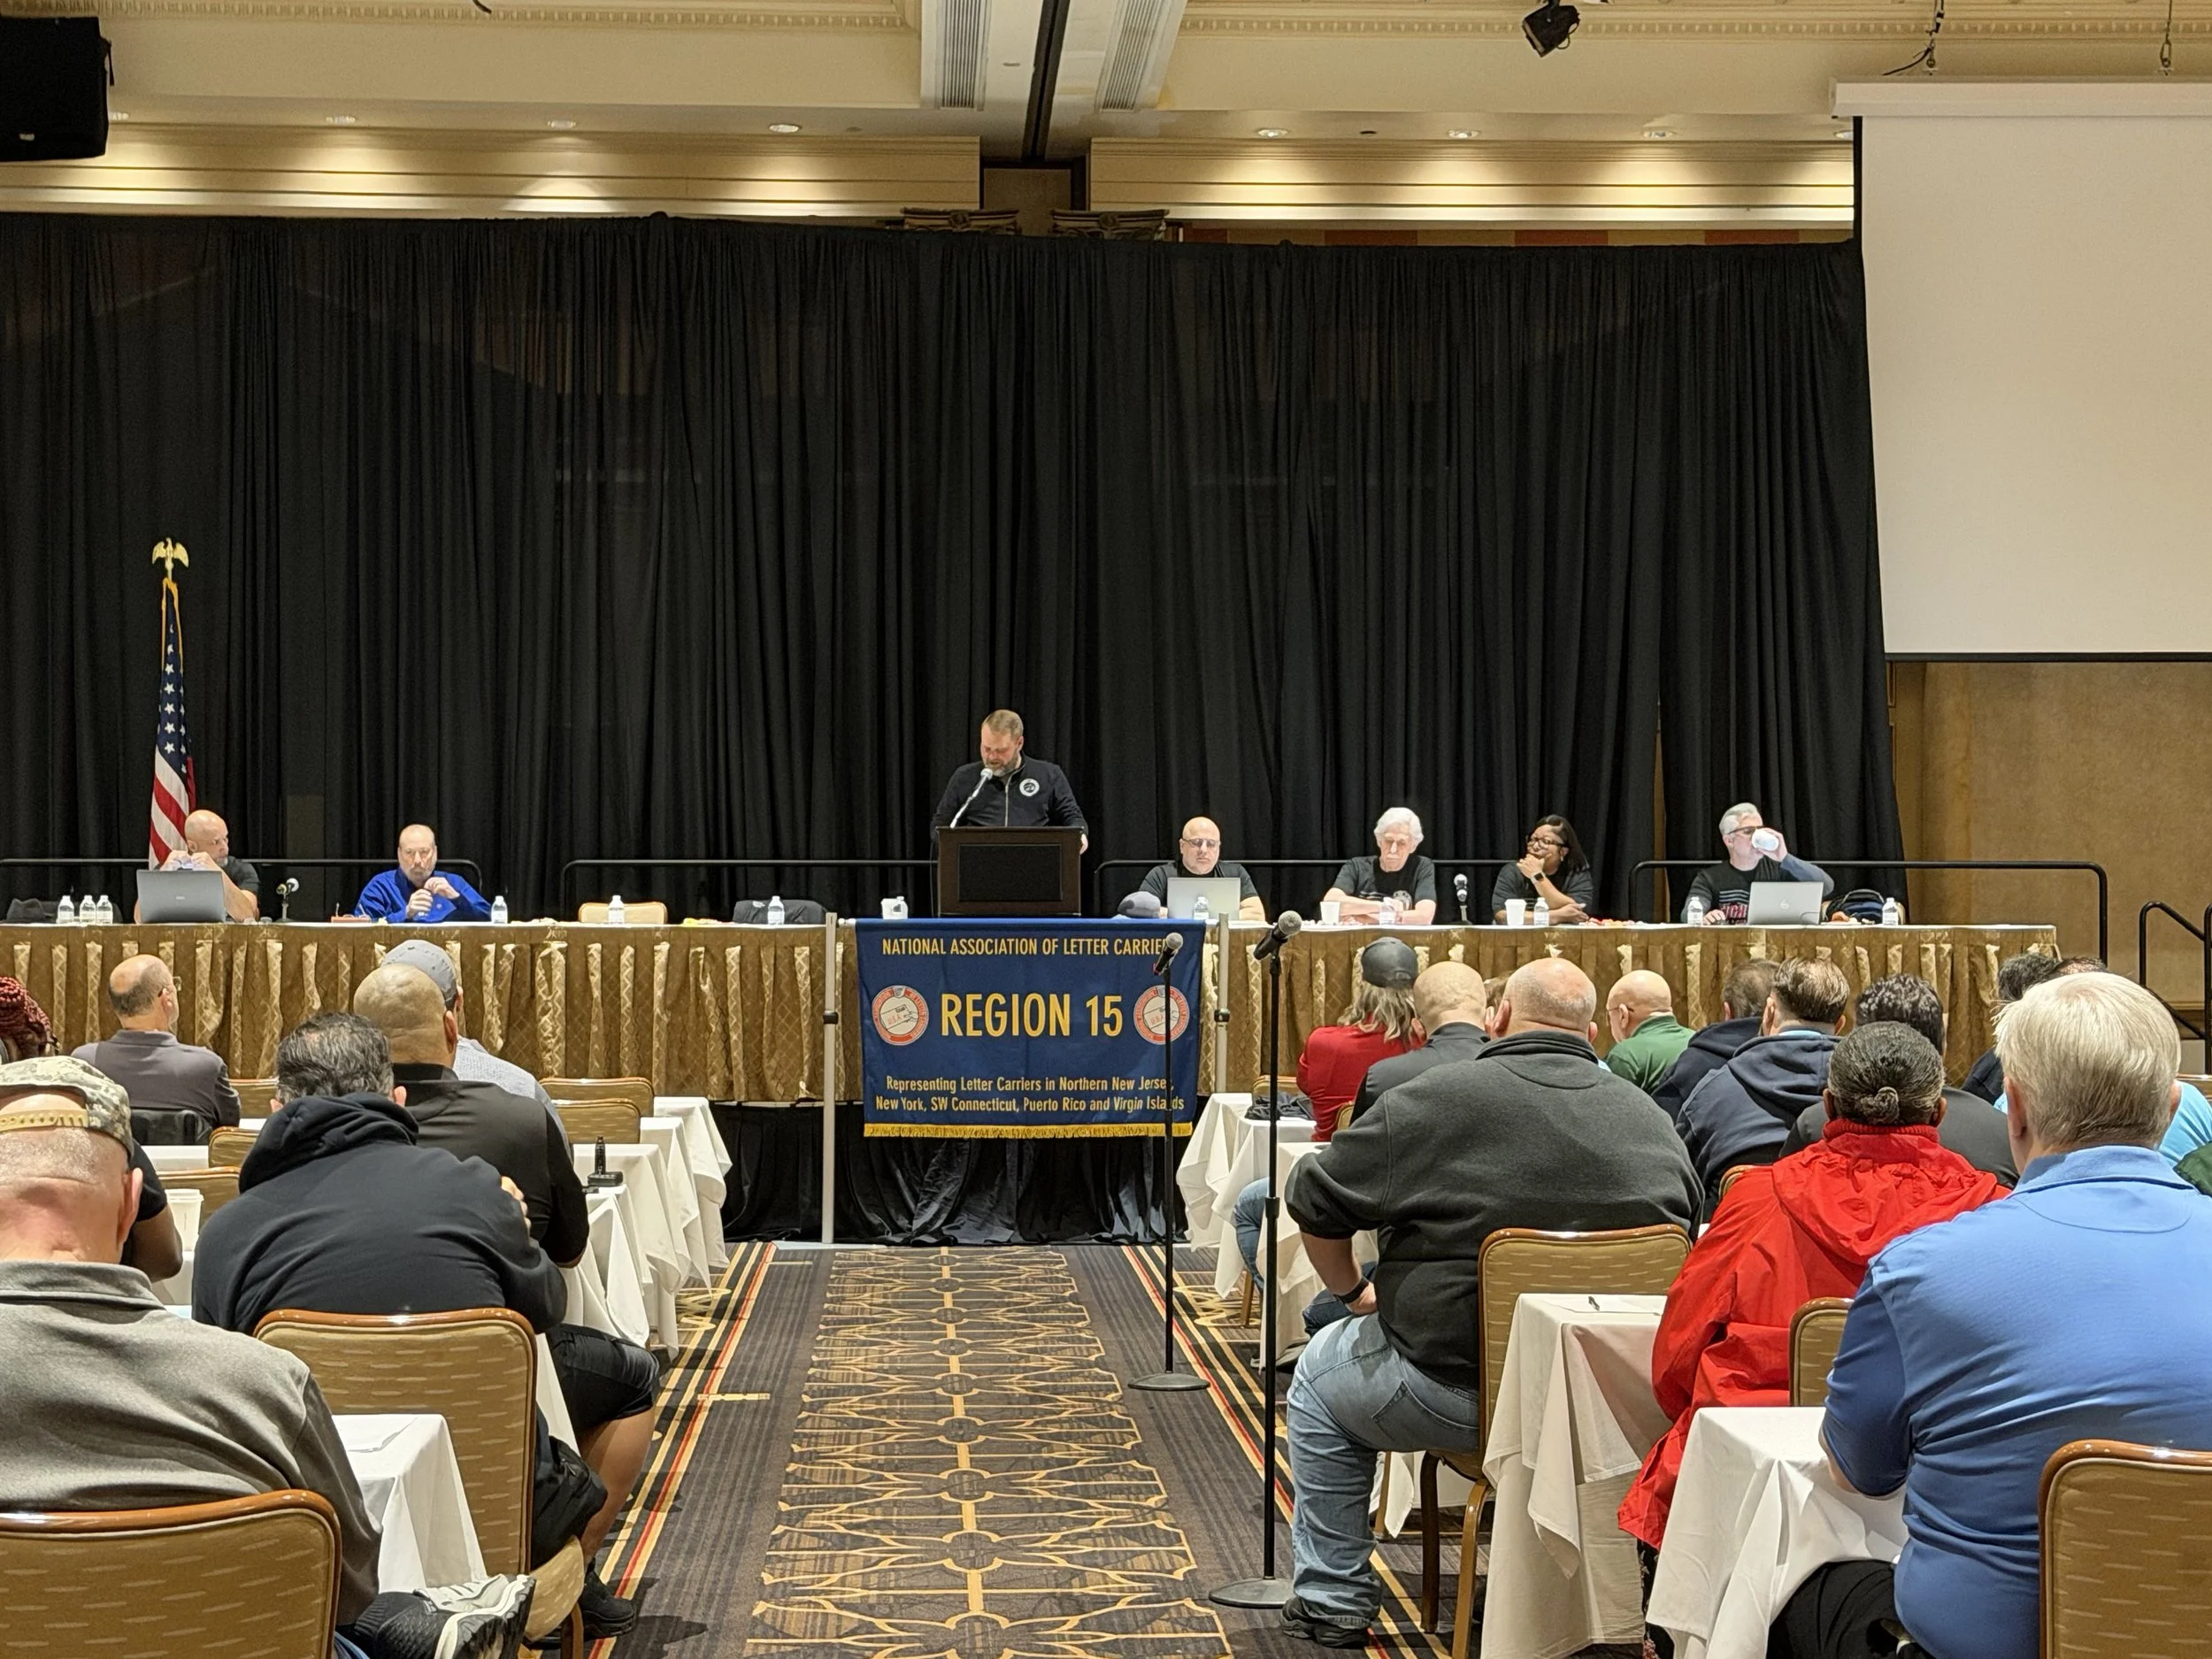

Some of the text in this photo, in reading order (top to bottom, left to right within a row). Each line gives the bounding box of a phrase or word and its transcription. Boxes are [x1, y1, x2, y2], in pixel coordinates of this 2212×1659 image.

[882, 938, 1170, 955] NATIONAL ASSOCIATION OF LETTER CARRIE
[941, 993, 1071, 1036] REGION
[1086, 995, 1123, 1036] 15
[887, 1075, 1174, 1094] Representing Letter Carriers in Northern New Jerse,
[876, 1095, 1185, 1113] New York, SW Connecticut, Puerto Rico and Virgin Islads
